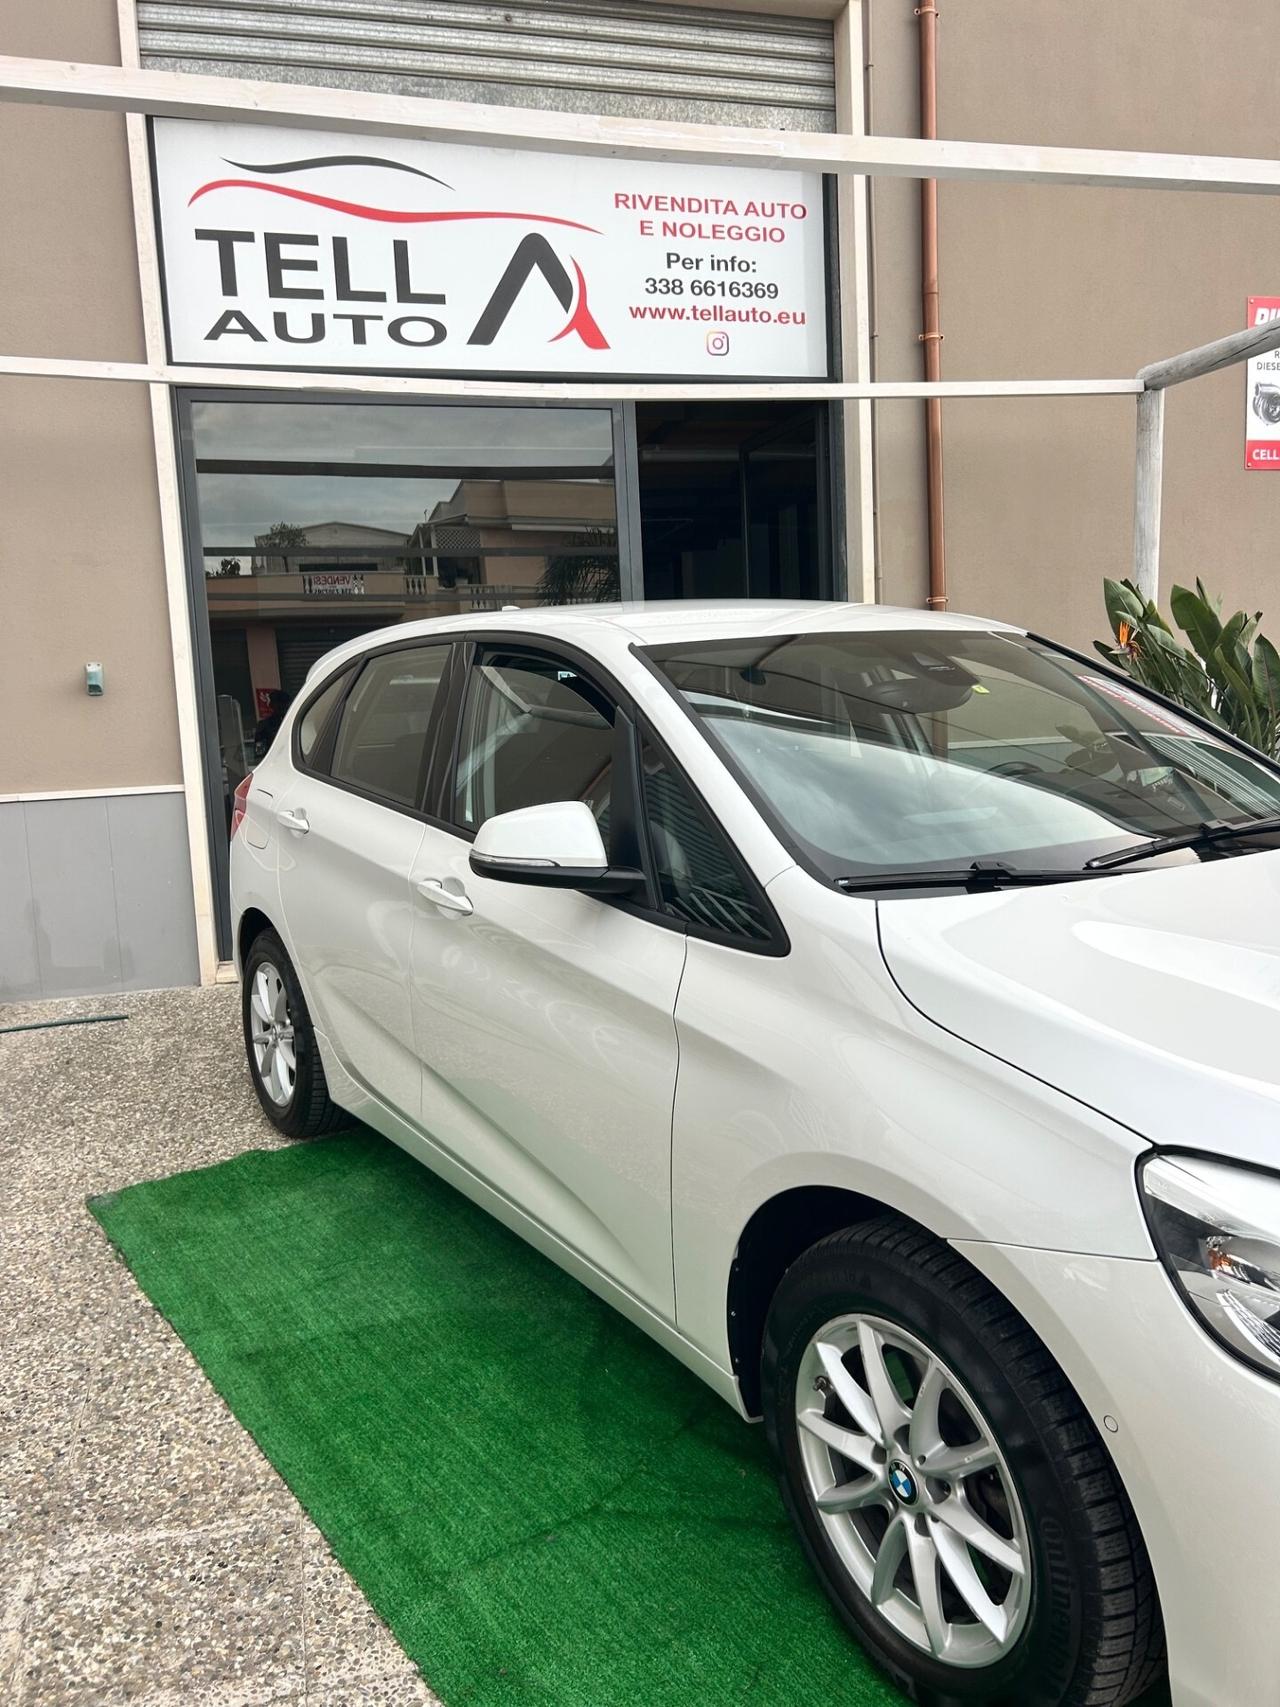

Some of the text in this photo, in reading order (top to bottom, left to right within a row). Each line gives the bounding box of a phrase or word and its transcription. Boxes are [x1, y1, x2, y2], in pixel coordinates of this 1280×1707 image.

[614, 193, 807, 219] RIVENDITA AUTO
[639, 220, 785, 243] E NOLEGGIO
[195, 228, 446, 305] TELL
[666, 252, 757, 273] Per info:
[645, 277, 779, 299] 338 6616369
[629, 305, 806, 325] www.tellauto.eu
[203, 309, 447, 347] AUTO
